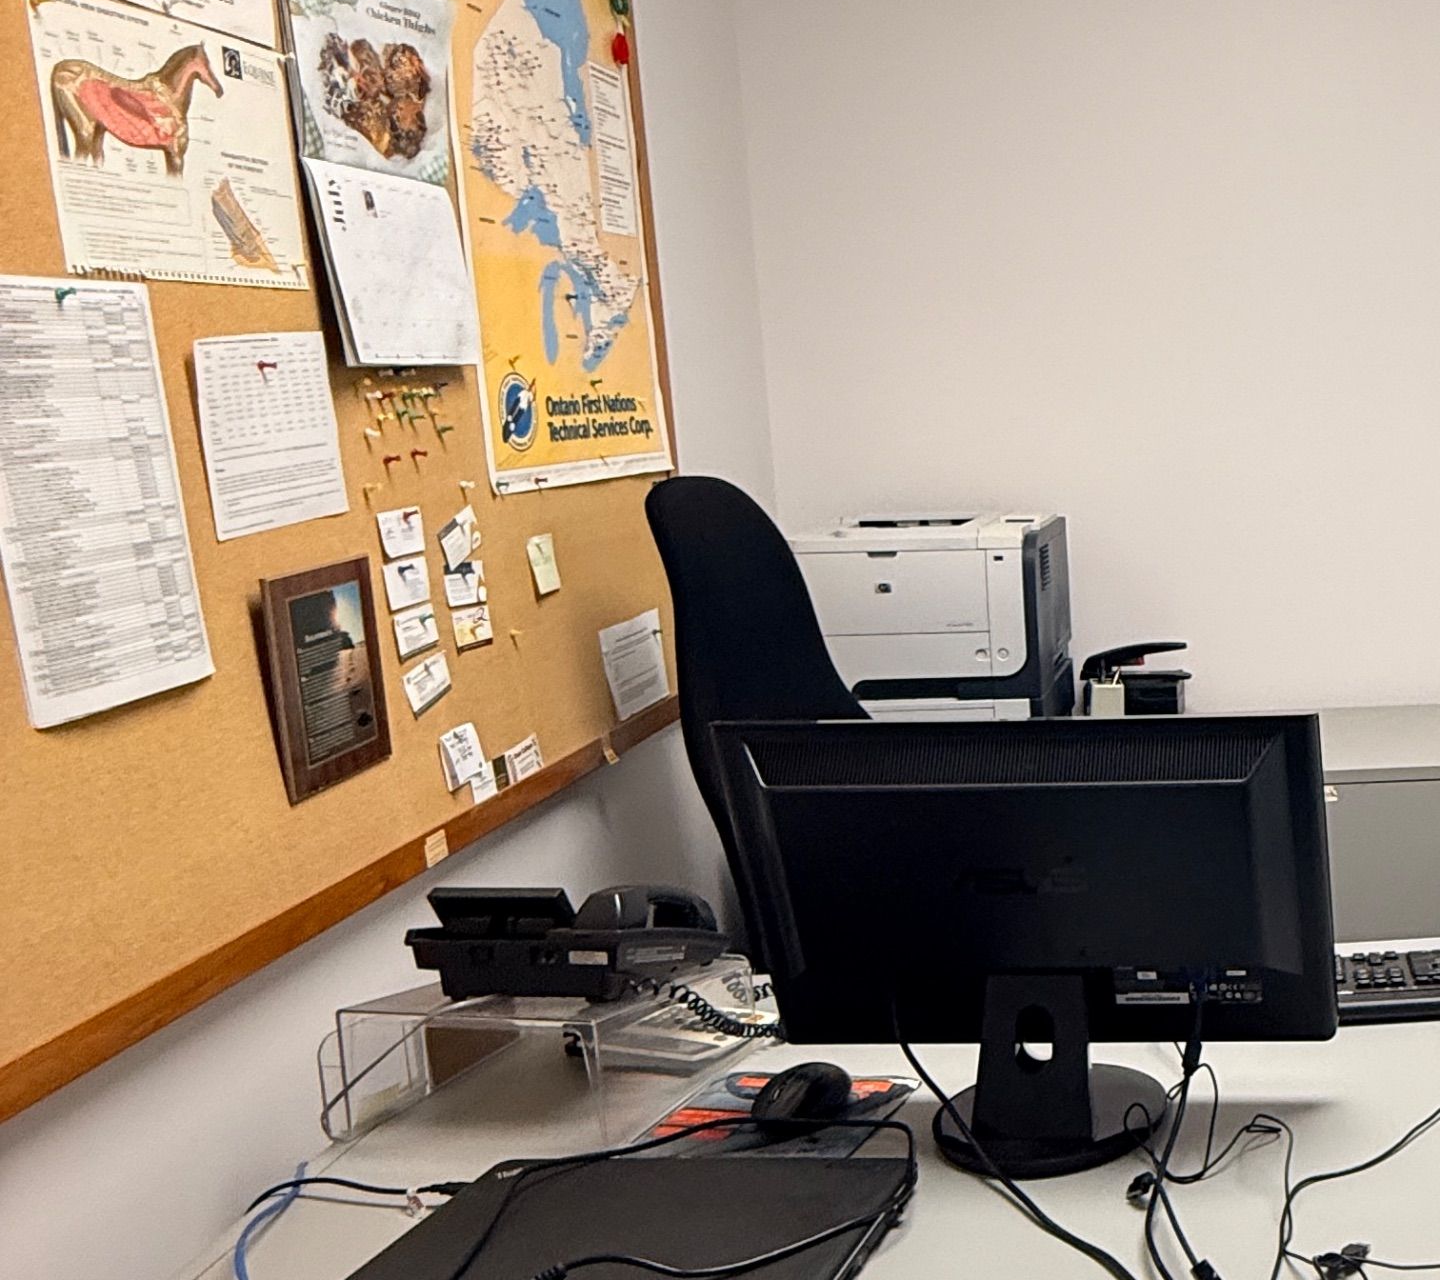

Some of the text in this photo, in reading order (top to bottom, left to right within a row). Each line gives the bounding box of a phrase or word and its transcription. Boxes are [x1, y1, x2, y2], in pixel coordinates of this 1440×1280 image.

[366, 2, 436, 34] Chicken Thighs
[545, 391, 638, 418] Ontario First Nations
[547, 415, 654, 443] Technical Services Corp.
